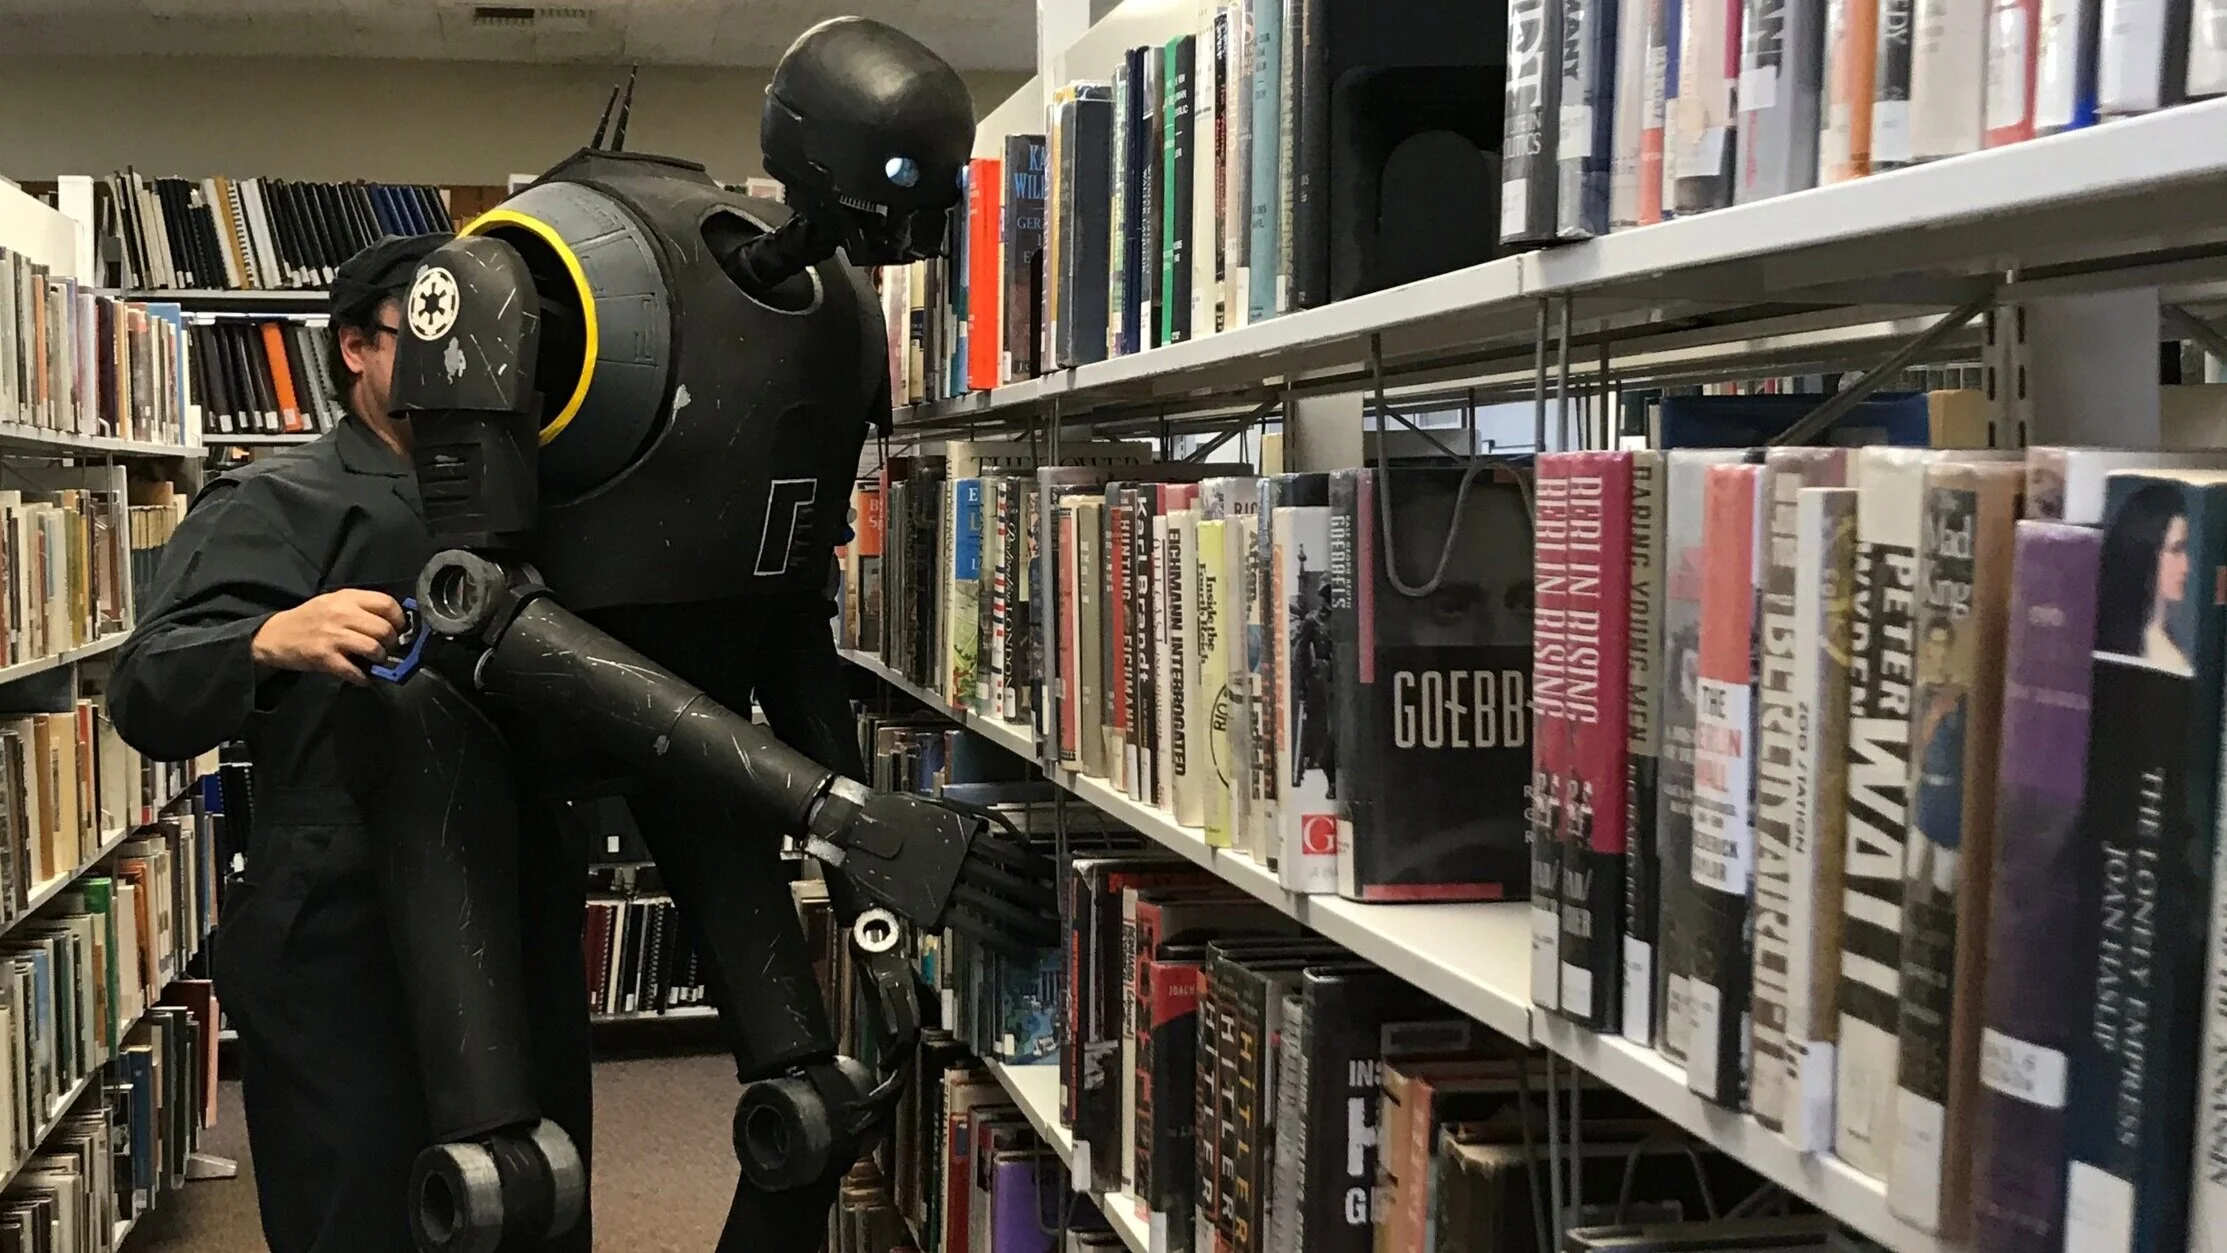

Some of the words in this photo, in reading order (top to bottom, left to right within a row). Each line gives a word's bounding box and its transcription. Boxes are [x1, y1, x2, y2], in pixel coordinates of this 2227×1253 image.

[1120, 519, 1132, 601] HUNTING
[1137, 496, 1148, 561] Karl
[1168, 527, 1183, 630] EICHMANN
[1199, 563, 1207, 617] Fourth
[1206, 576, 1217, 624] Inside
[1003, 608, 1014, 688] LONDON
[1137, 575, 1150, 683] Brandt
[1200, 618, 1209, 664] Reich
[1208, 626, 1218, 653] the
[1878, 553, 1915, 716] PETER
[1171, 636, 1186, 776] INTERROGATED
[1394, 670, 1535, 748] GOEBB
[2138, 767, 2166, 838] THE
[2102, 840, 2128, 932] JOAN
[1203, 1001, 1218, 1203] HITLER
[2116, 997, 2147, 1147] EMPRESS
[1220, 1014, 1238, 1220] HITLER
[1236, 1031, 1256, 1243] HITLER
